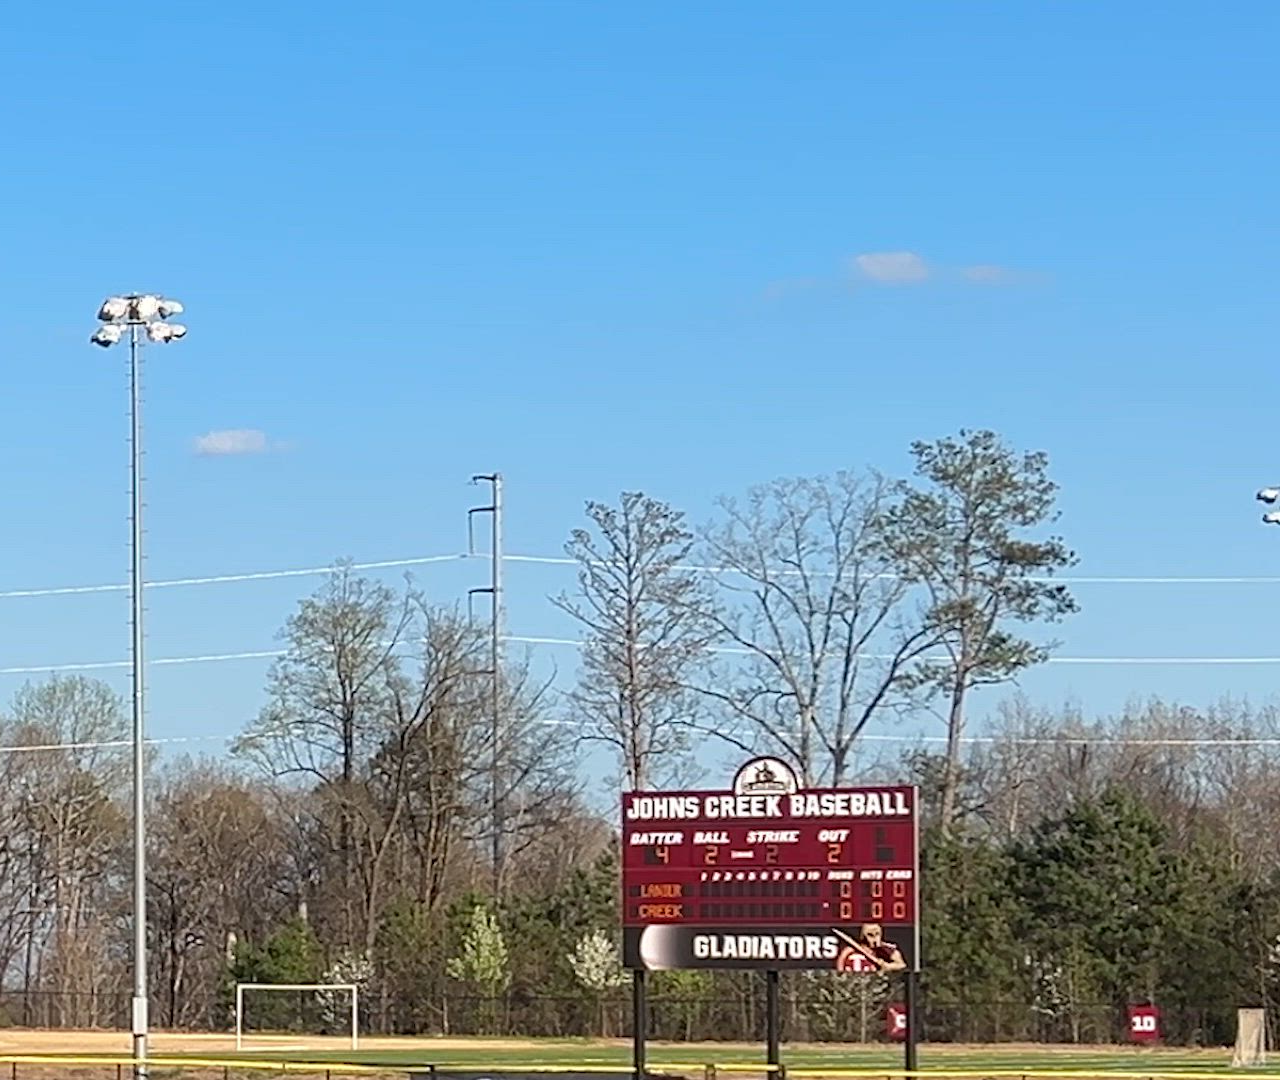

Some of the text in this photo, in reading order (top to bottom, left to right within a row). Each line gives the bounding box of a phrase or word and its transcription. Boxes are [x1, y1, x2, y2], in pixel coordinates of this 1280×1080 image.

[627, 792, 910, 819] JOHNS CREEK BASEBALL
[629, 829, 850, 845] BATTER BALL STRIKE OUT
[654, 843, 842, 865] 4 2 2 2
[840, 881, 852, 898] 0
[871, 881, 883, 898] 0
[893, 881, 905, 897] 0
[639, 901, 905, 919] CREEK 0 0 0
[694, 935, 838, 960] GLADIATORS
[1131, 1015, 1156, 1032] 10
